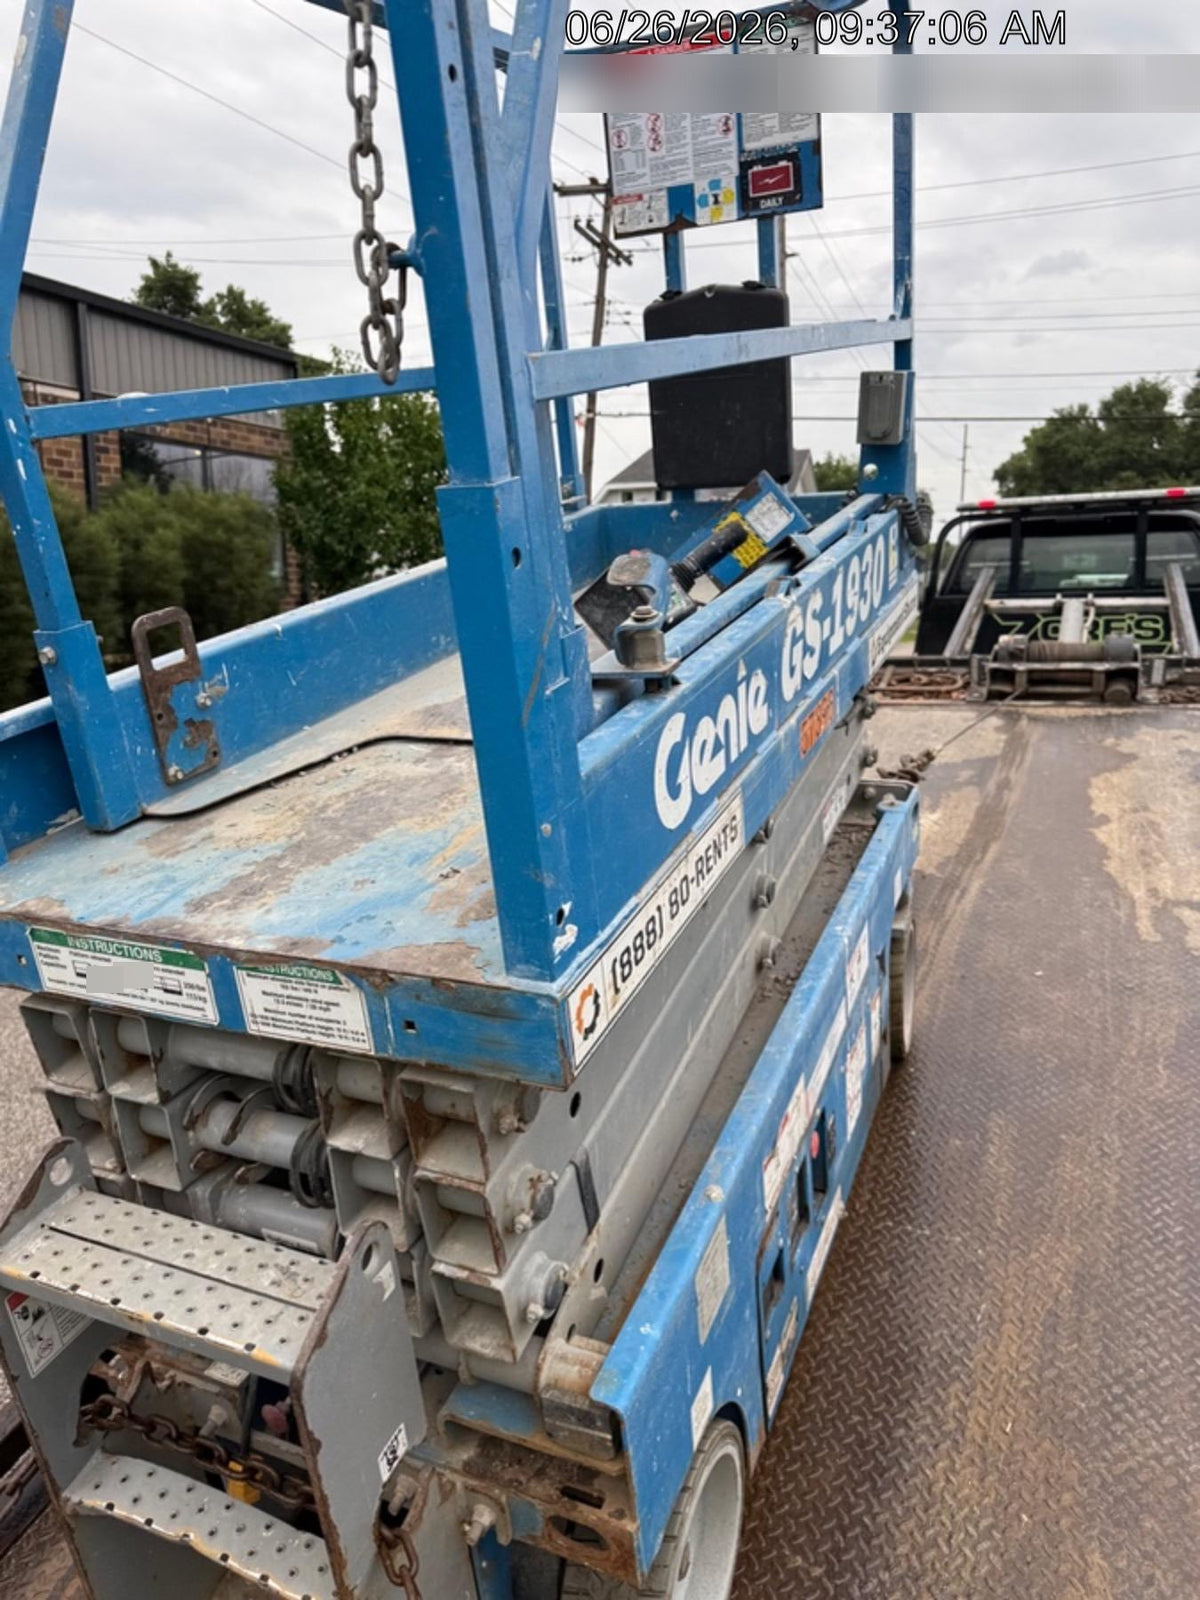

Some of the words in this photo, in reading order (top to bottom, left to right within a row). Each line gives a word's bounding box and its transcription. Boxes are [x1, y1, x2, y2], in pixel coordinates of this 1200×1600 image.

[653, 659, 769, 830] Genie
[781, 533, 886, 703] GS-1930
[66, 937, 163, 962] INSTRUCTIONS
[611, 906, 664, 996] (888)
